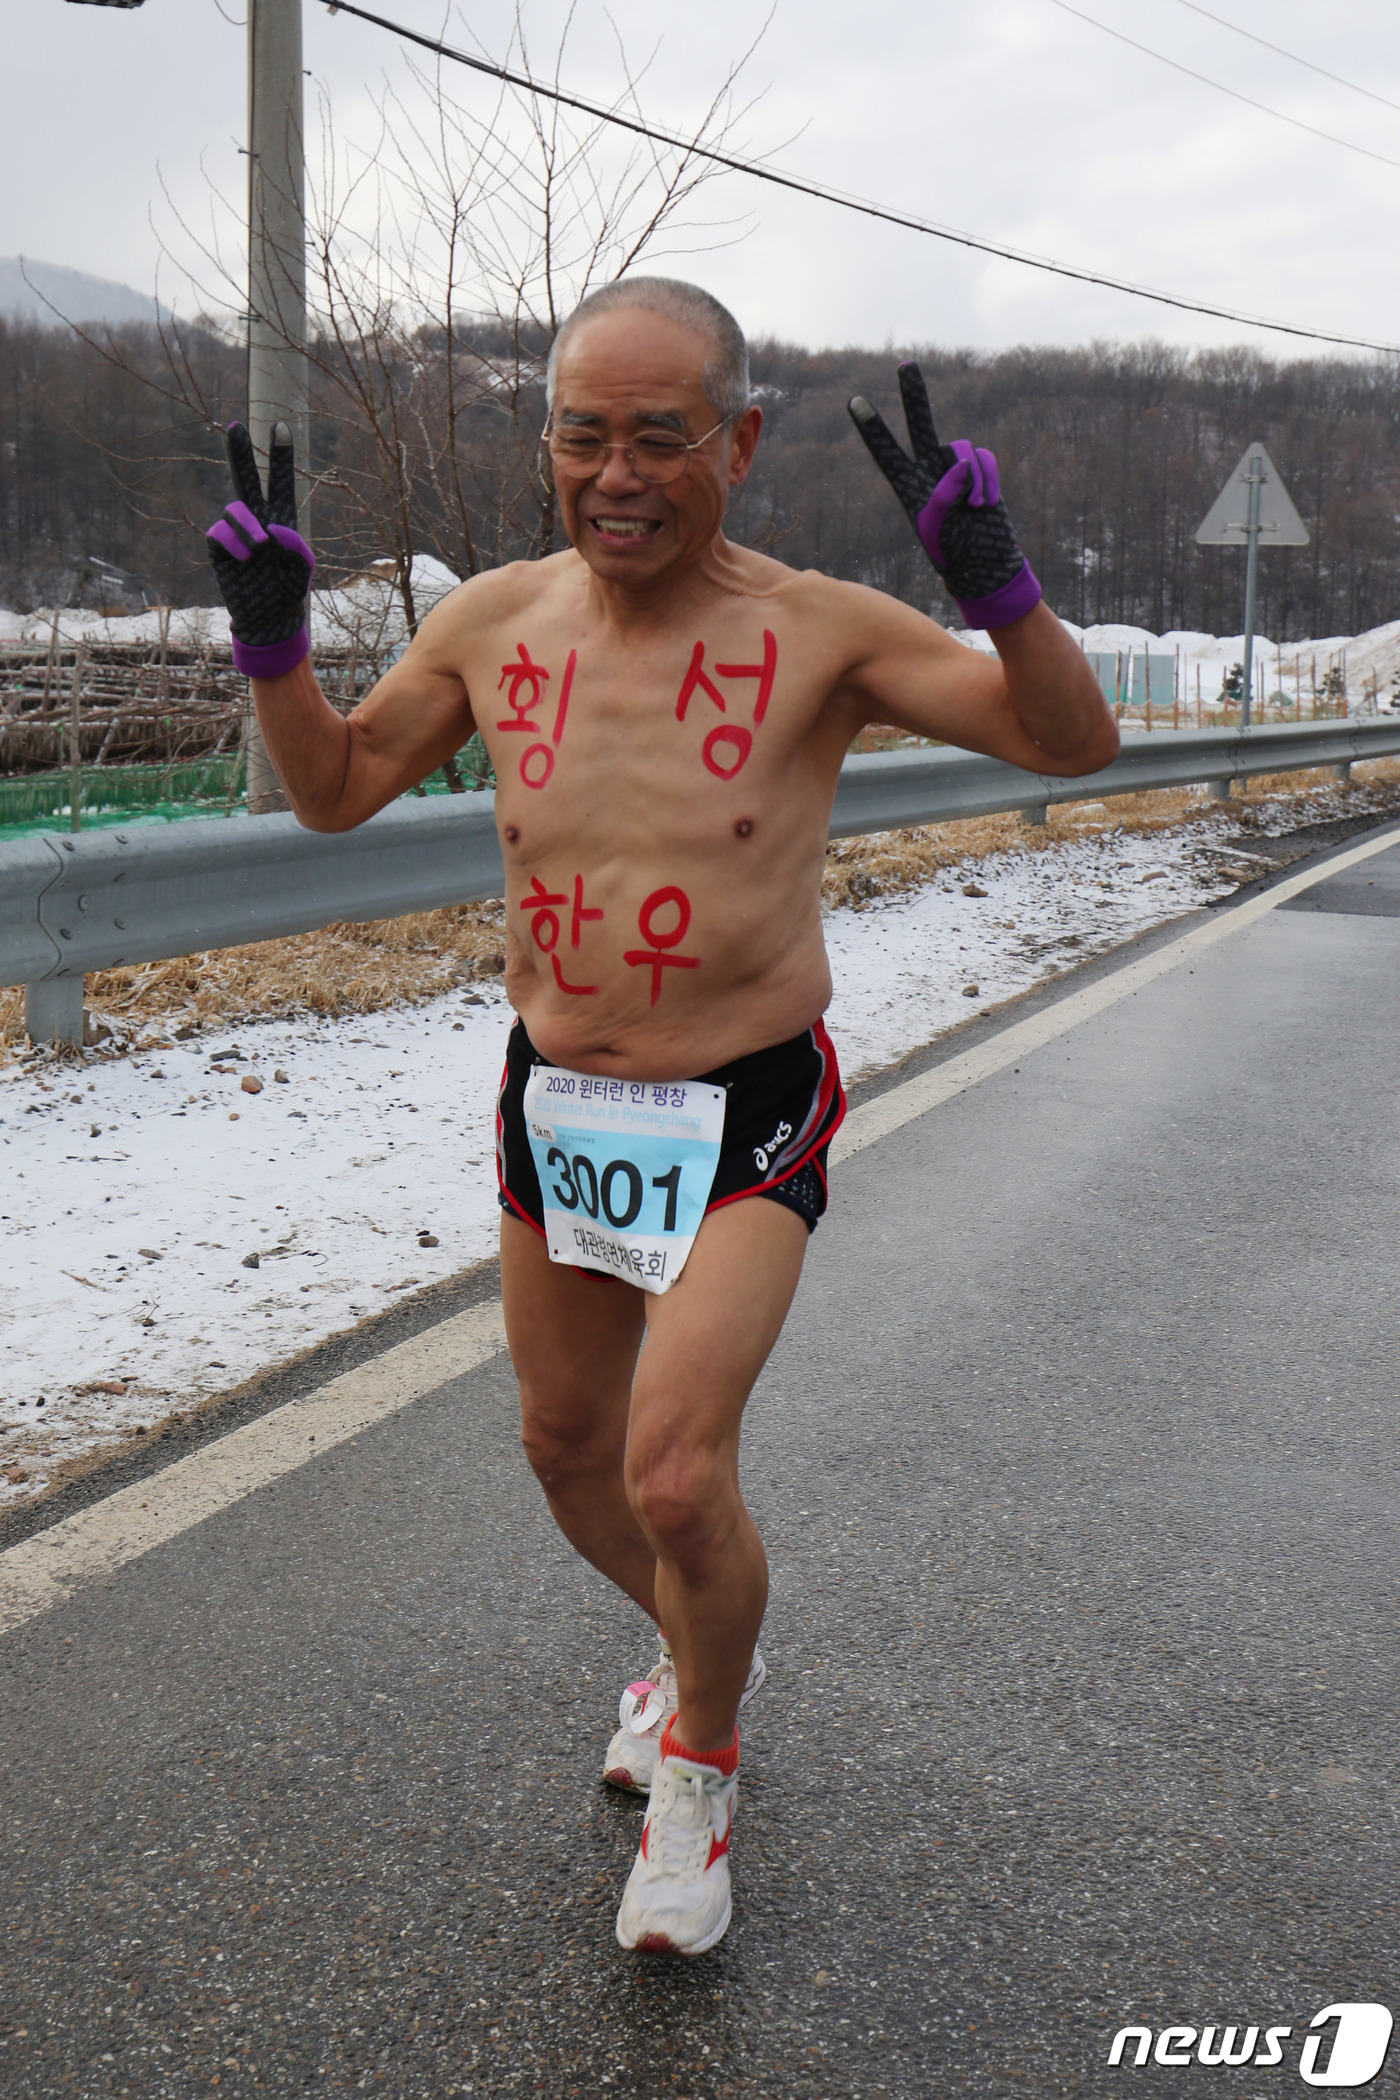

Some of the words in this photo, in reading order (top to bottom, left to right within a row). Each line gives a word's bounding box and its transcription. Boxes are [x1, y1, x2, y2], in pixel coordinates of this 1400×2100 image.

[496, 628, 778, 790] 횡성
[519, 872, 702, 1009] 한우
[546, 1076, 576, 1095] 2020
[579, 1079, 624, 1102] 윈터런
[629, 1083, 646, 1104] 인
[651, 1085, 688, 1108] 평창
[553, 1098, 583, 1116] Winter
[586, 1102, 606, 1119] Run
[622, 1105, 702, 1132] Pyeongchang
[532, 1123, 553, 1140] 5km
[547, 1147, 682, 1232] 3001
